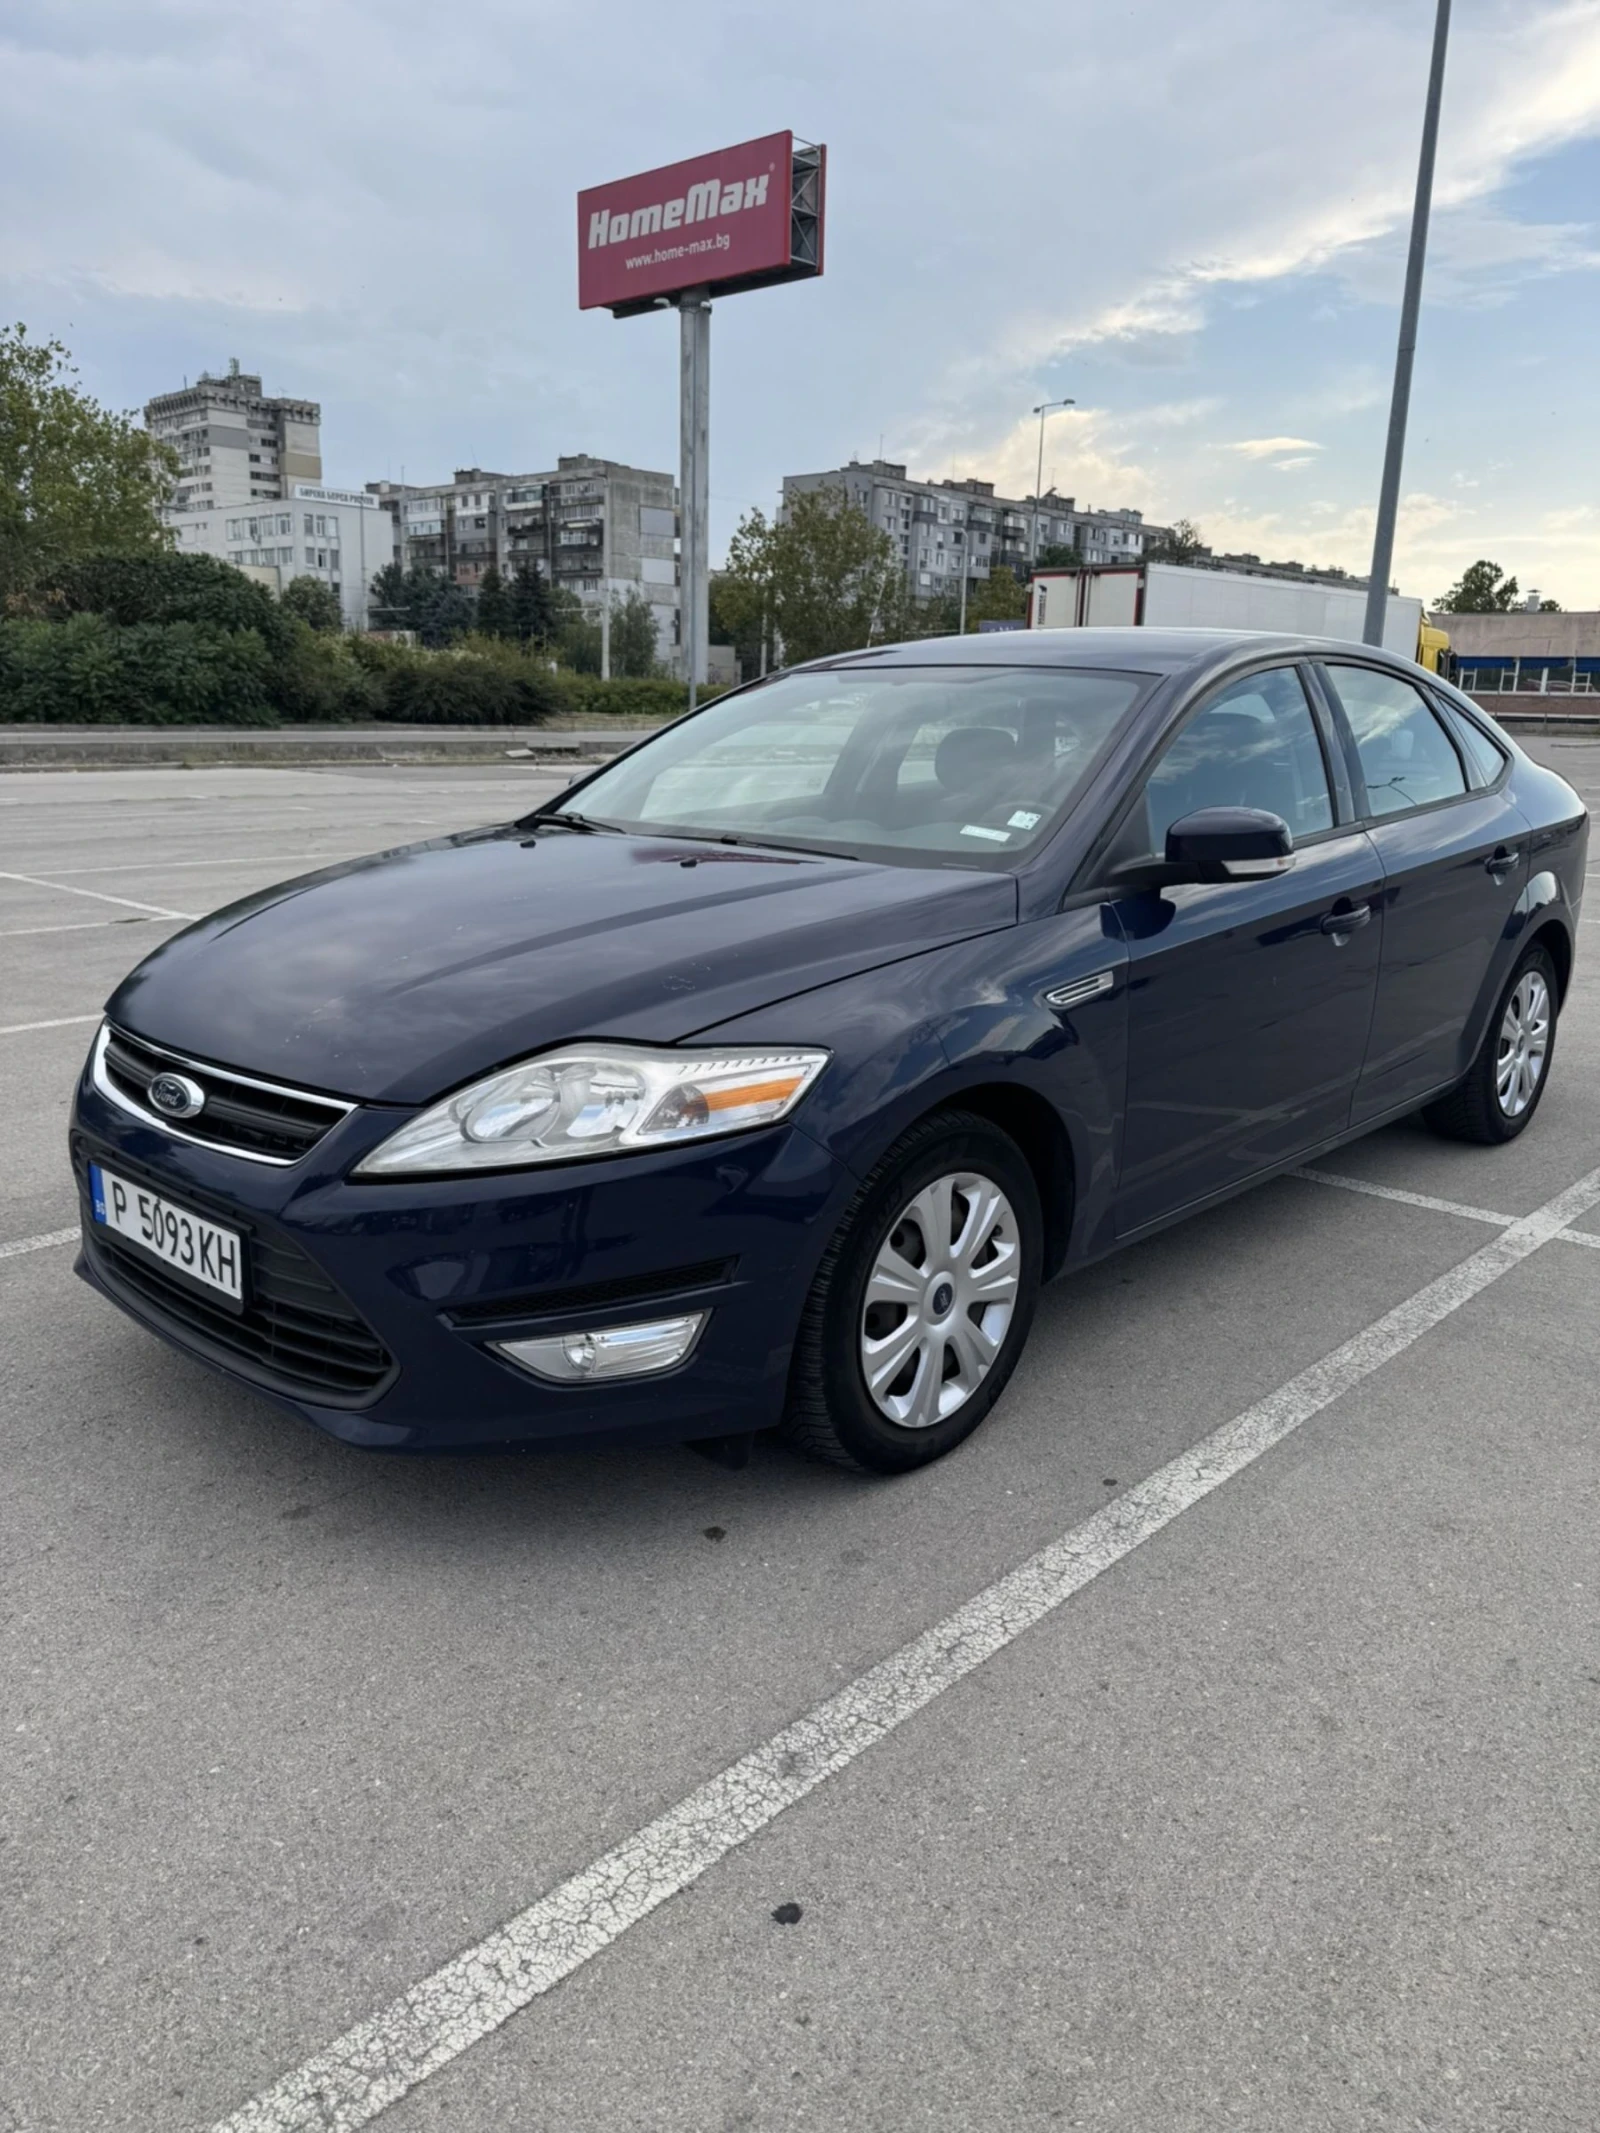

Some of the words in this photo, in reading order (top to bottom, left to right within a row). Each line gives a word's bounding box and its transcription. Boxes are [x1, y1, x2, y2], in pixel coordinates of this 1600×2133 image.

[588, 174, 770, 250] HomeMax
[625, 233, 730, 270] www.home-max.bg
[155, 1082, 181, 1106] Ford
